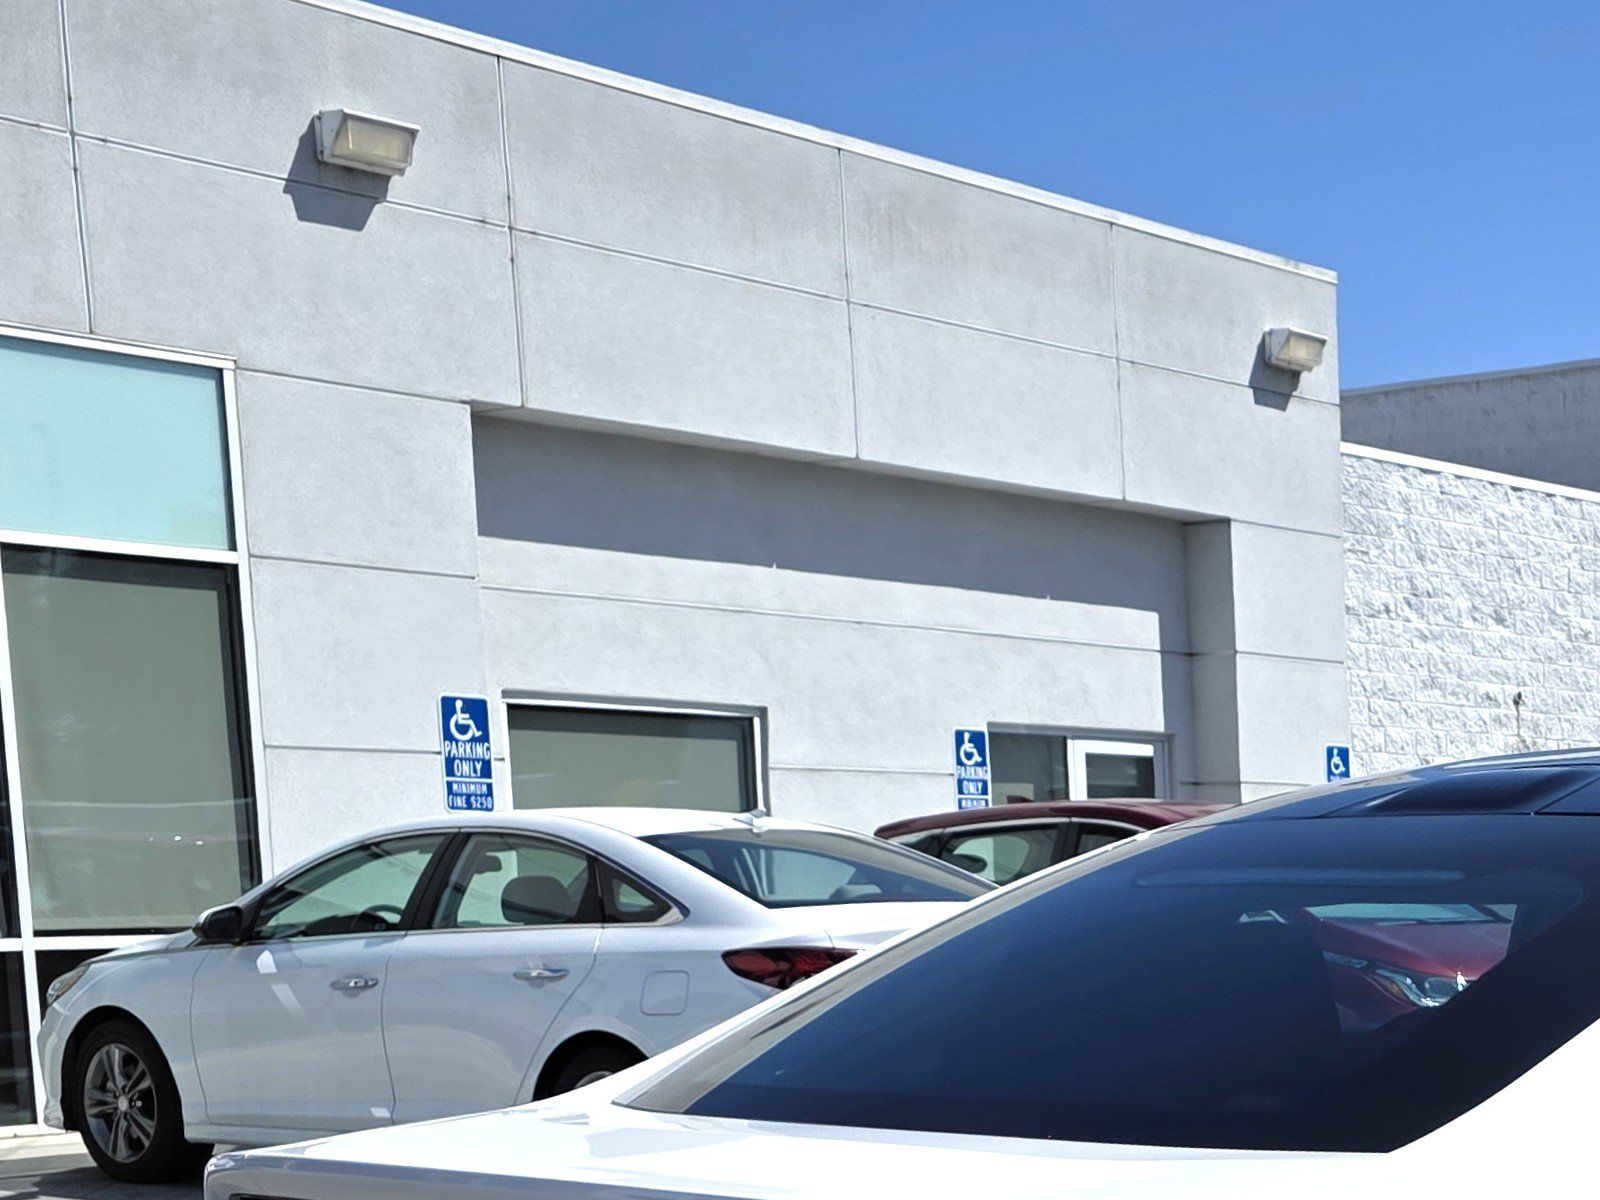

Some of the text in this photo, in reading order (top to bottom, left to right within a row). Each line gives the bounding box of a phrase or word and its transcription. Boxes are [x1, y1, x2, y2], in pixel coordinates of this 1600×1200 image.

[444, 741, 490, 759] PARKING
[454, 760, 482, 777] ONLY
[957, 766, 988, 779] PARKING
[452, 782, 488, 794] MINIMUM
[963, 781, 983, 794] ONLY
[448, 795, 493, 809] FINE $250
